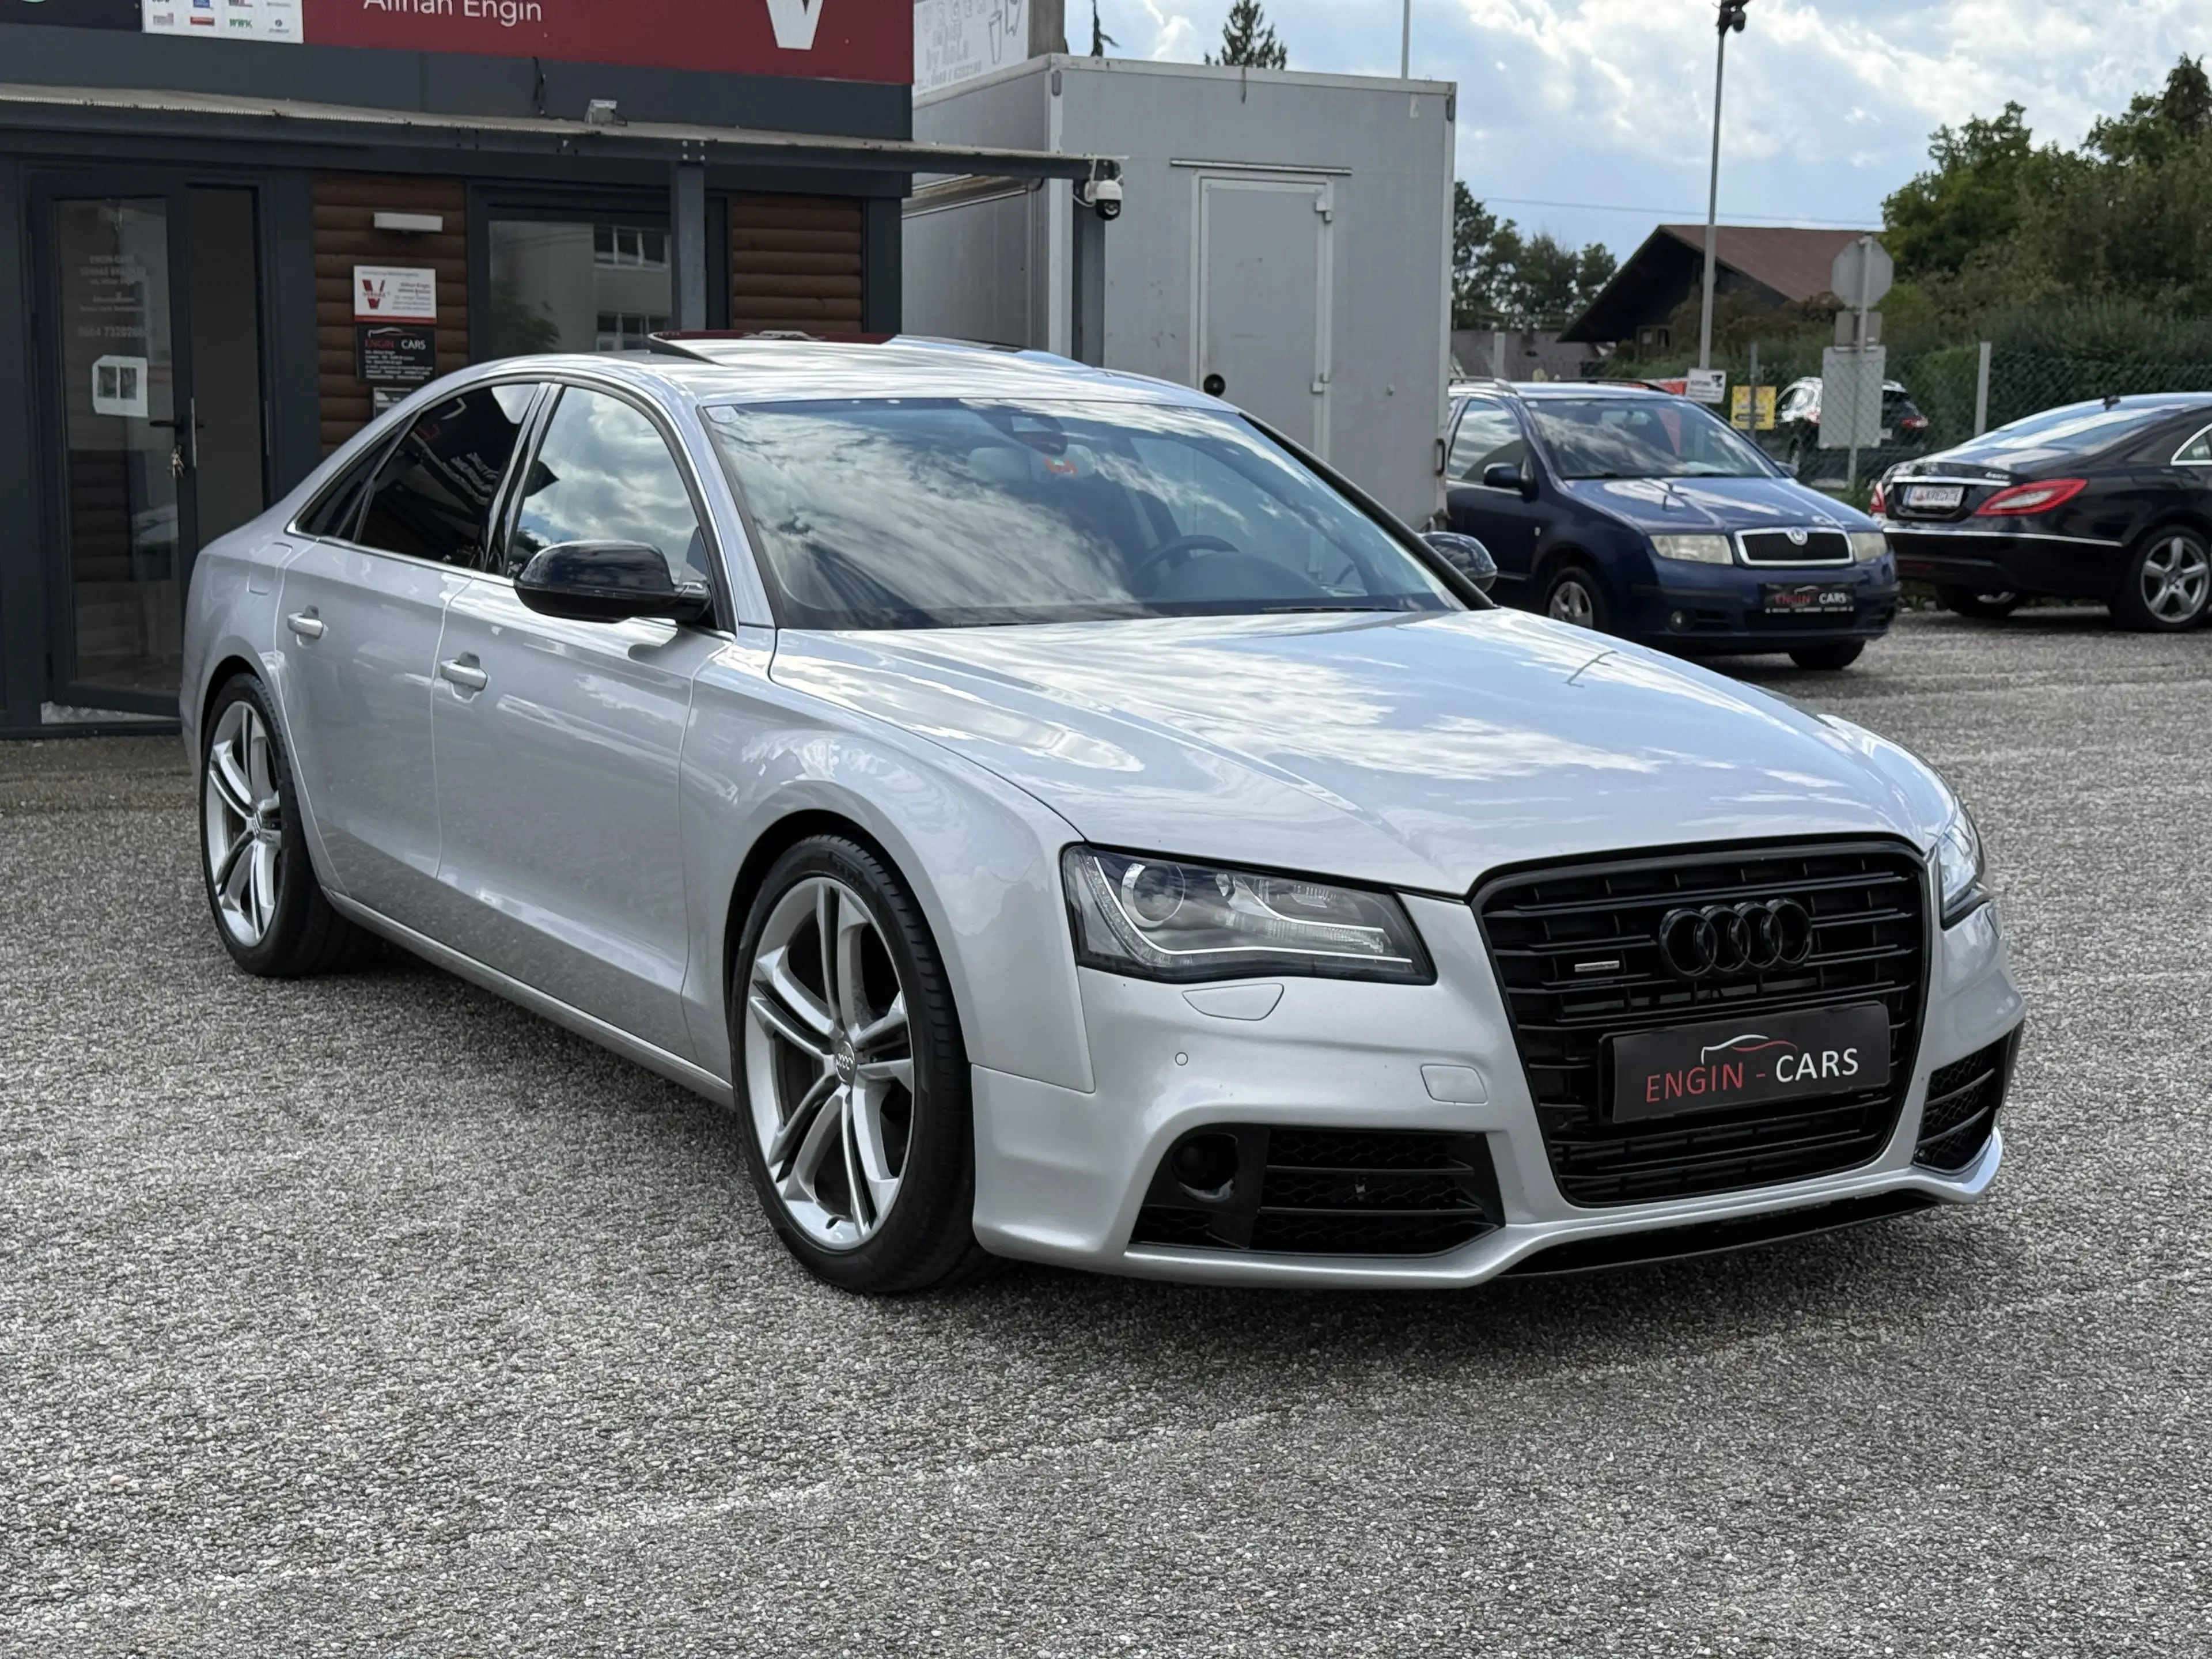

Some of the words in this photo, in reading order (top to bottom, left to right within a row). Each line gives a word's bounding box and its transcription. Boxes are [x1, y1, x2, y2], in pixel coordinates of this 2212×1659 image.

[464, 0, 542, 27] Engin
[229, 18, 252, 28] WWK
[365, 339, 395, 349] ENGIN
[401, 339, 426, 350] CARS
[1819, 592, 1847, 604] CARS
[1646, 1062, 1743, 1103] ENGIN
[1775, 1047, 1859, 1083] CARS
